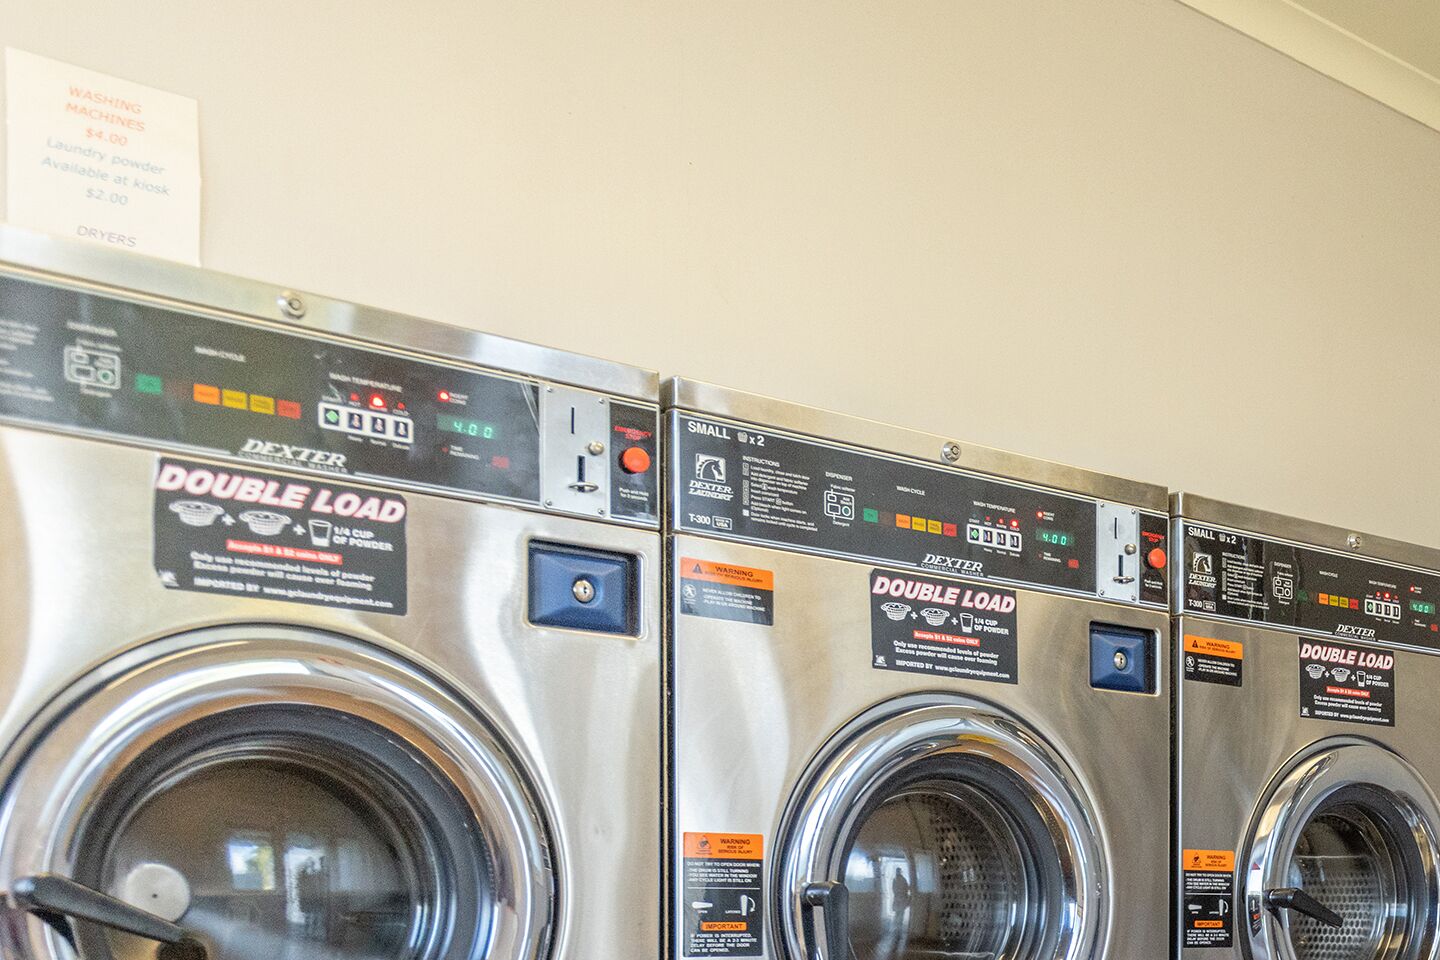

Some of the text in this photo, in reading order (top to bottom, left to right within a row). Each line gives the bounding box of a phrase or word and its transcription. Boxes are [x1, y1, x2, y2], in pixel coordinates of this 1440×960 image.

[69, 86, 142, 114] WASHING
[66, 102, 146, 132] MACHINES
[86, 128, 128, 146] $4.00
[47, 137, 165, 175] Laundry powder
[42, 156, 171, 196] Available at kiosk
[86, 188, 129, 206] $2.00
[77, 225, 137, 248] DRYERS
[688, 421, 731, 440] SMALL
[240, 438, 347, 467] DEXTER
[826, 472, 853, 482] DISPENSER
[156, 464, 407, 523] DOUBLE LOAD
[689, 480, 734, 494] DEXTER
[910, 488, 926, 496] CYCLE
[986, 503, 1016, 514] TEMPERATURE
[689, 513, 711, 525] T-300
[334, 526, 375, 539] 1/4 CUP
[1188, 526, 1215, 540] SMALL
[332, 536, 394, 552] OF POWDER
[715, 566, 754, 577] WARNING
[921, 563, 958, 574] COMMERCIAL
[922, 554, 983, 573] DEXTER
[872, 576, 1016, 613] DOUBLE LOAD
[974, 618, 998, 627] 1/4 CUP
[974, 624, 1009, 636] OF POWDER
[1336, 624, 1375, 637] DEXTER
[894, 640, 907, 649] Only
[918, 644, 957, 654] recommended
[957, 648, 973, 656] levels
[980, 652, 999, 660] powder
[896, 647, 915, 655] Excess
[916, 650, 936, 658] powder
[1300, 644, 1394, 670] DOUBLE LOAD
[896, 659, 925, 669] IMPORTED
